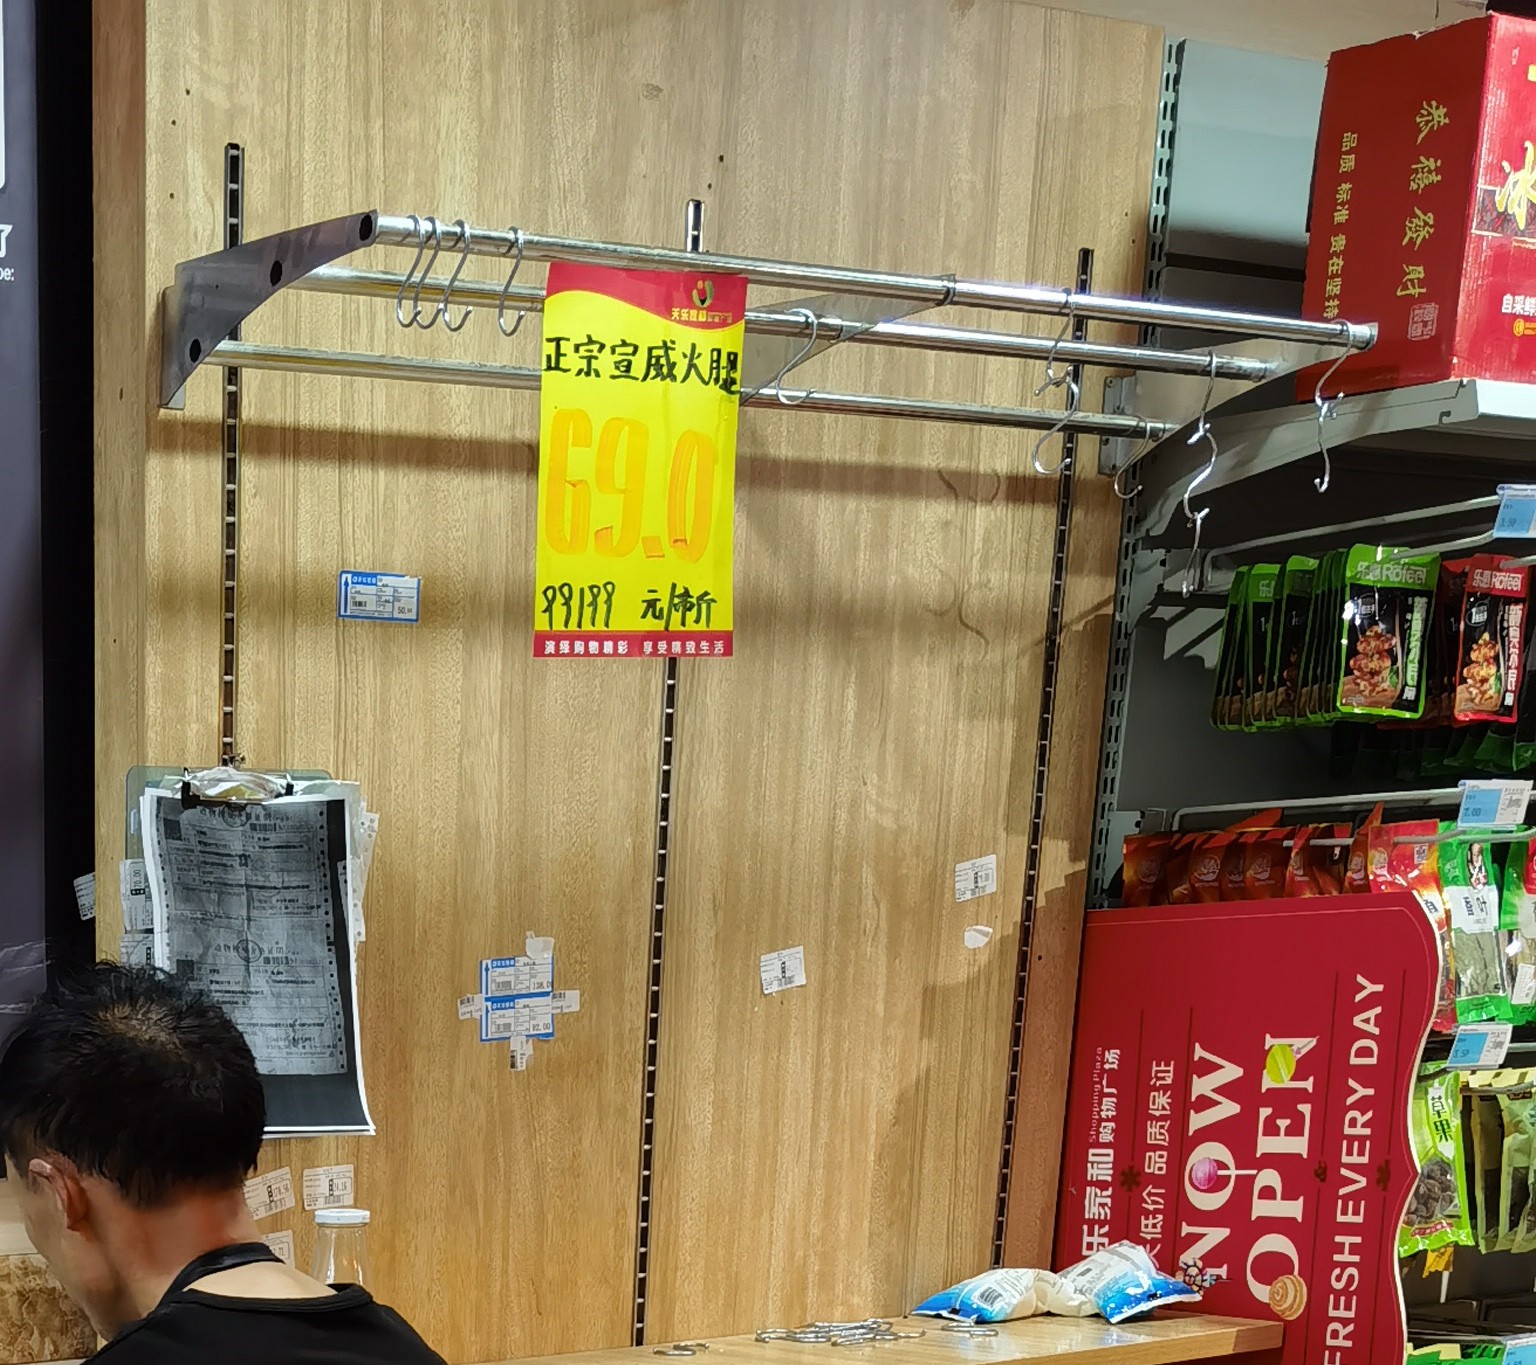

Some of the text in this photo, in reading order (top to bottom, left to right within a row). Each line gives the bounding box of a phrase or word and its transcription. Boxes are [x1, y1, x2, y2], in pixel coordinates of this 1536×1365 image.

[542, 334, 742, 395] 正宗宣威火腿
[1349, 973, 1384, 1066] DAY
[1089, 1083, 1101, 1143] Shopping
[1099, 1049, 1121, 1143] 购物广场
[1145, 1060, 1175, 1175] 品质保证
[1179, 1042, 1244, 1280] NOW
[1246, 1033, 1319, 1303] OPEN
[1336, 1077, 1375, 1224] EVERY
